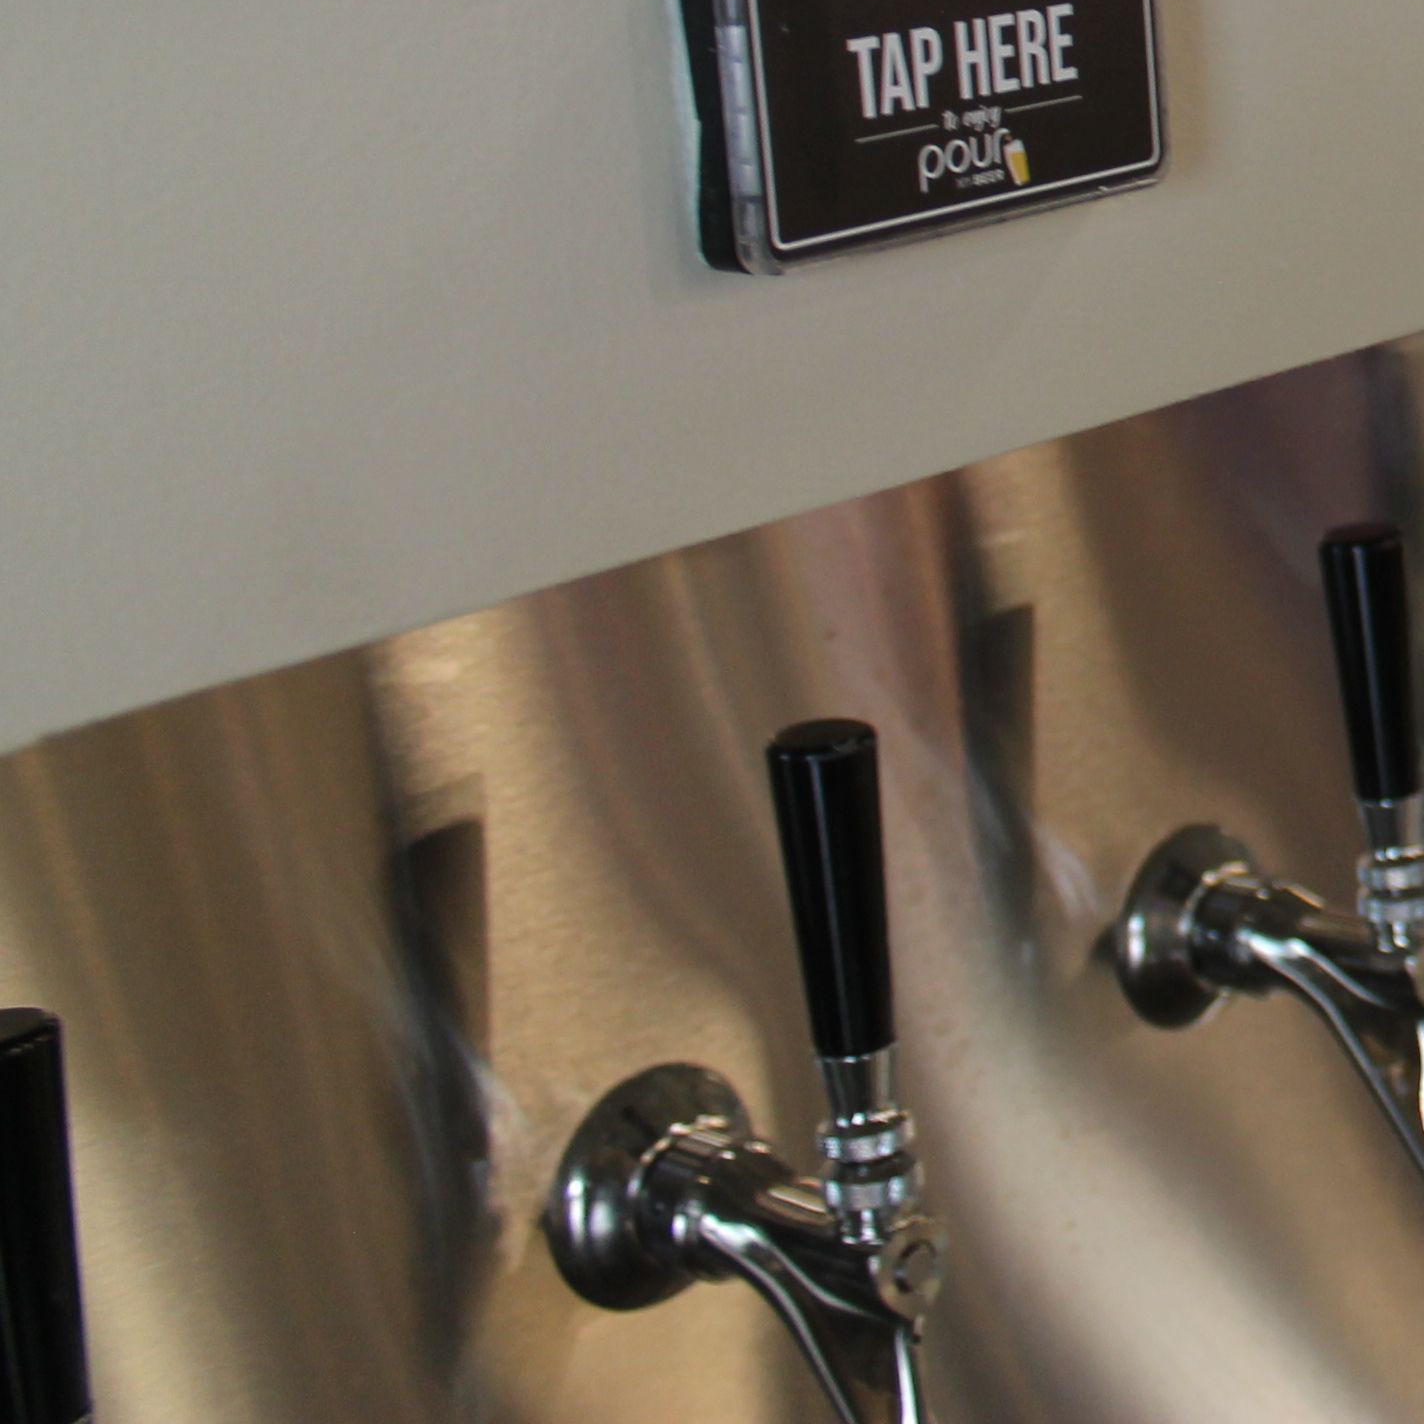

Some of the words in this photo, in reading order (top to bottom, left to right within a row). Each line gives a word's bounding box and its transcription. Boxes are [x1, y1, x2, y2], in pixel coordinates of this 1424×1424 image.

[846, 26, 944, 120] TAP
[953, 2, 1079, 101] HERE
[917, 127, 1013, 195] pour
